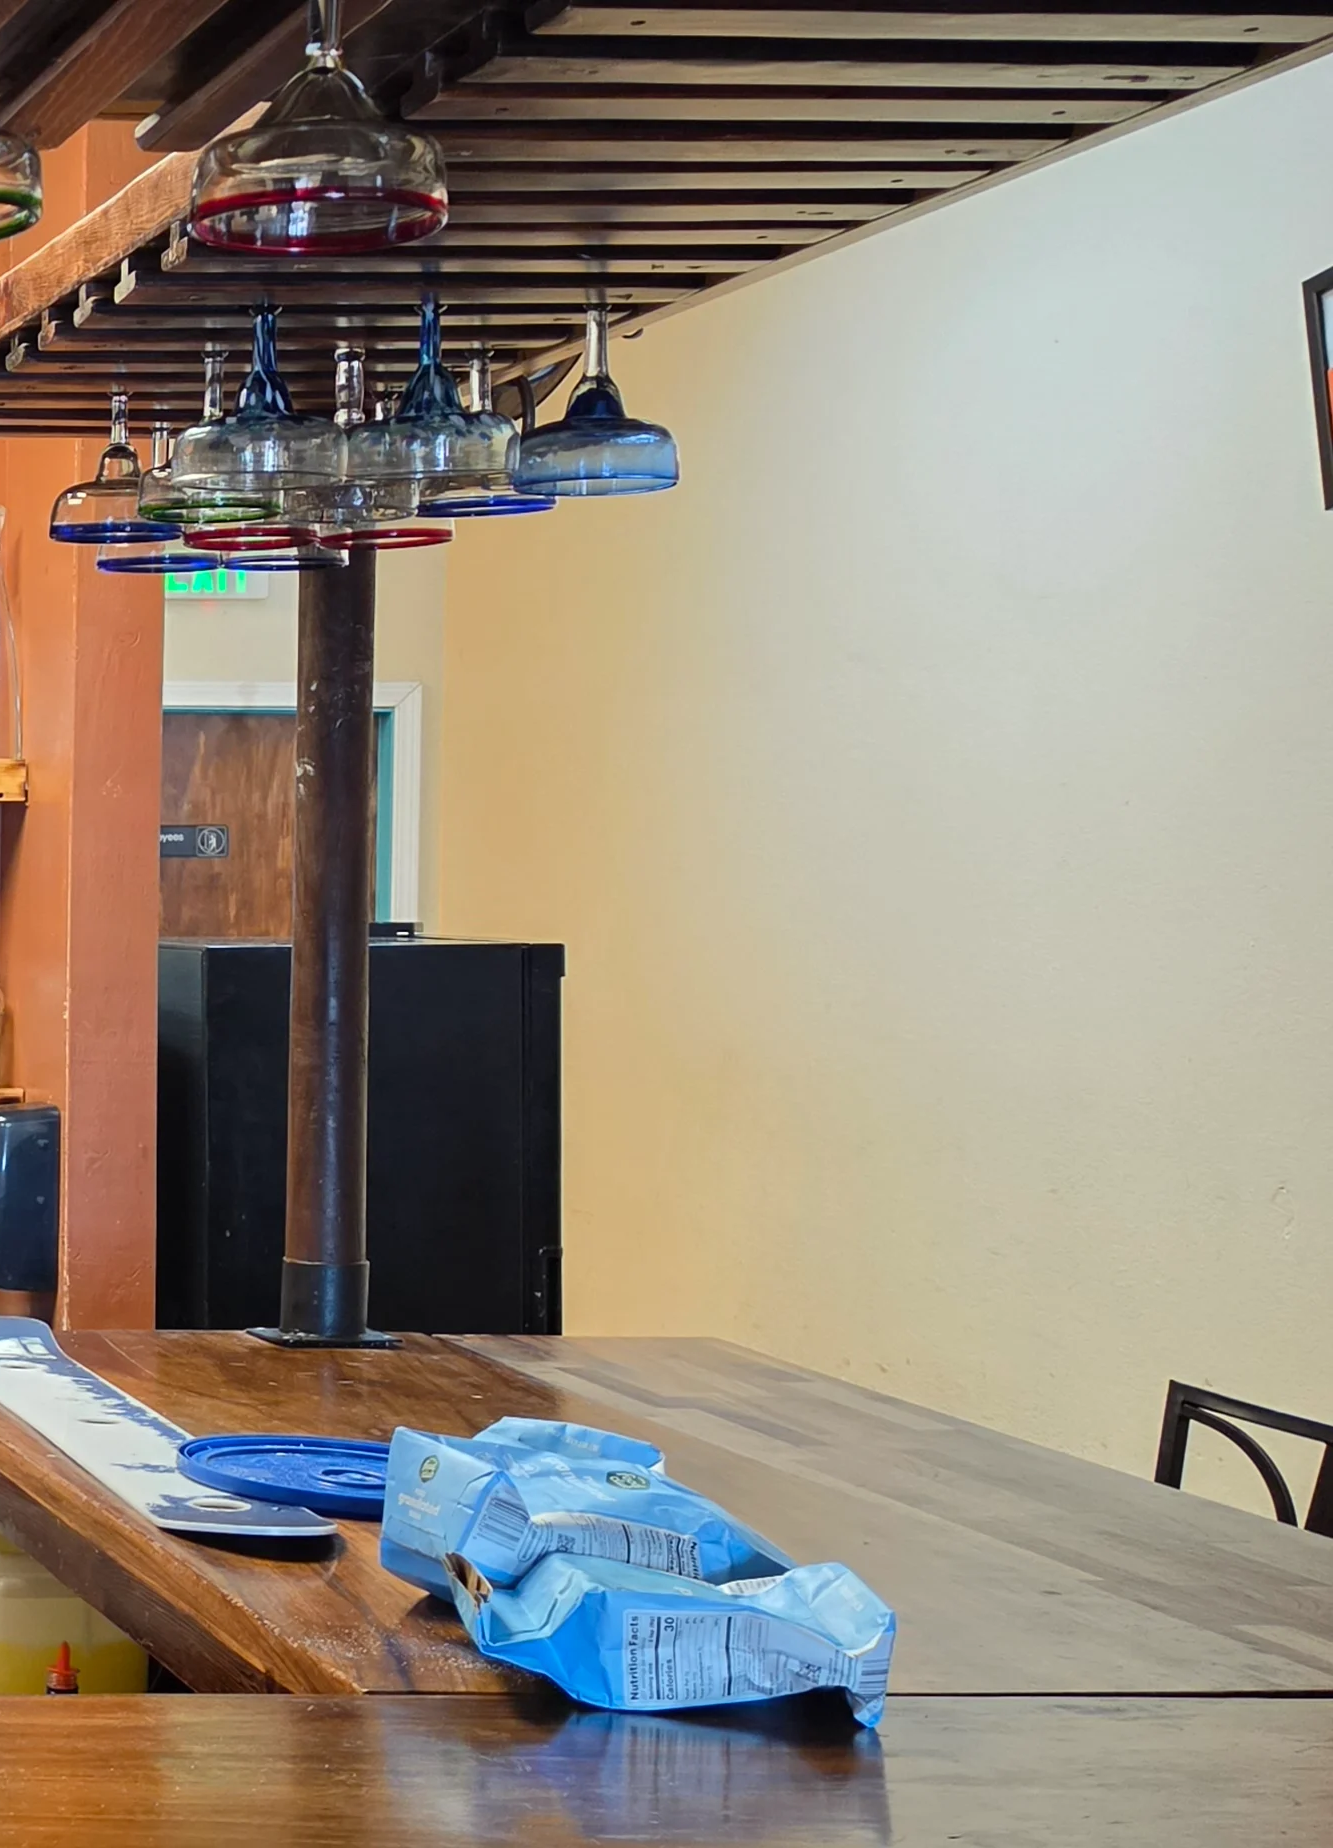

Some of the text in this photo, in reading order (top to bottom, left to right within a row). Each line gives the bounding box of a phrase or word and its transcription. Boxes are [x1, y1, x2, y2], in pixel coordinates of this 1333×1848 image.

[629, 1615, 641, 1700] Nutrition Facts
[664, 1616, 675, 1701] Calories 30
